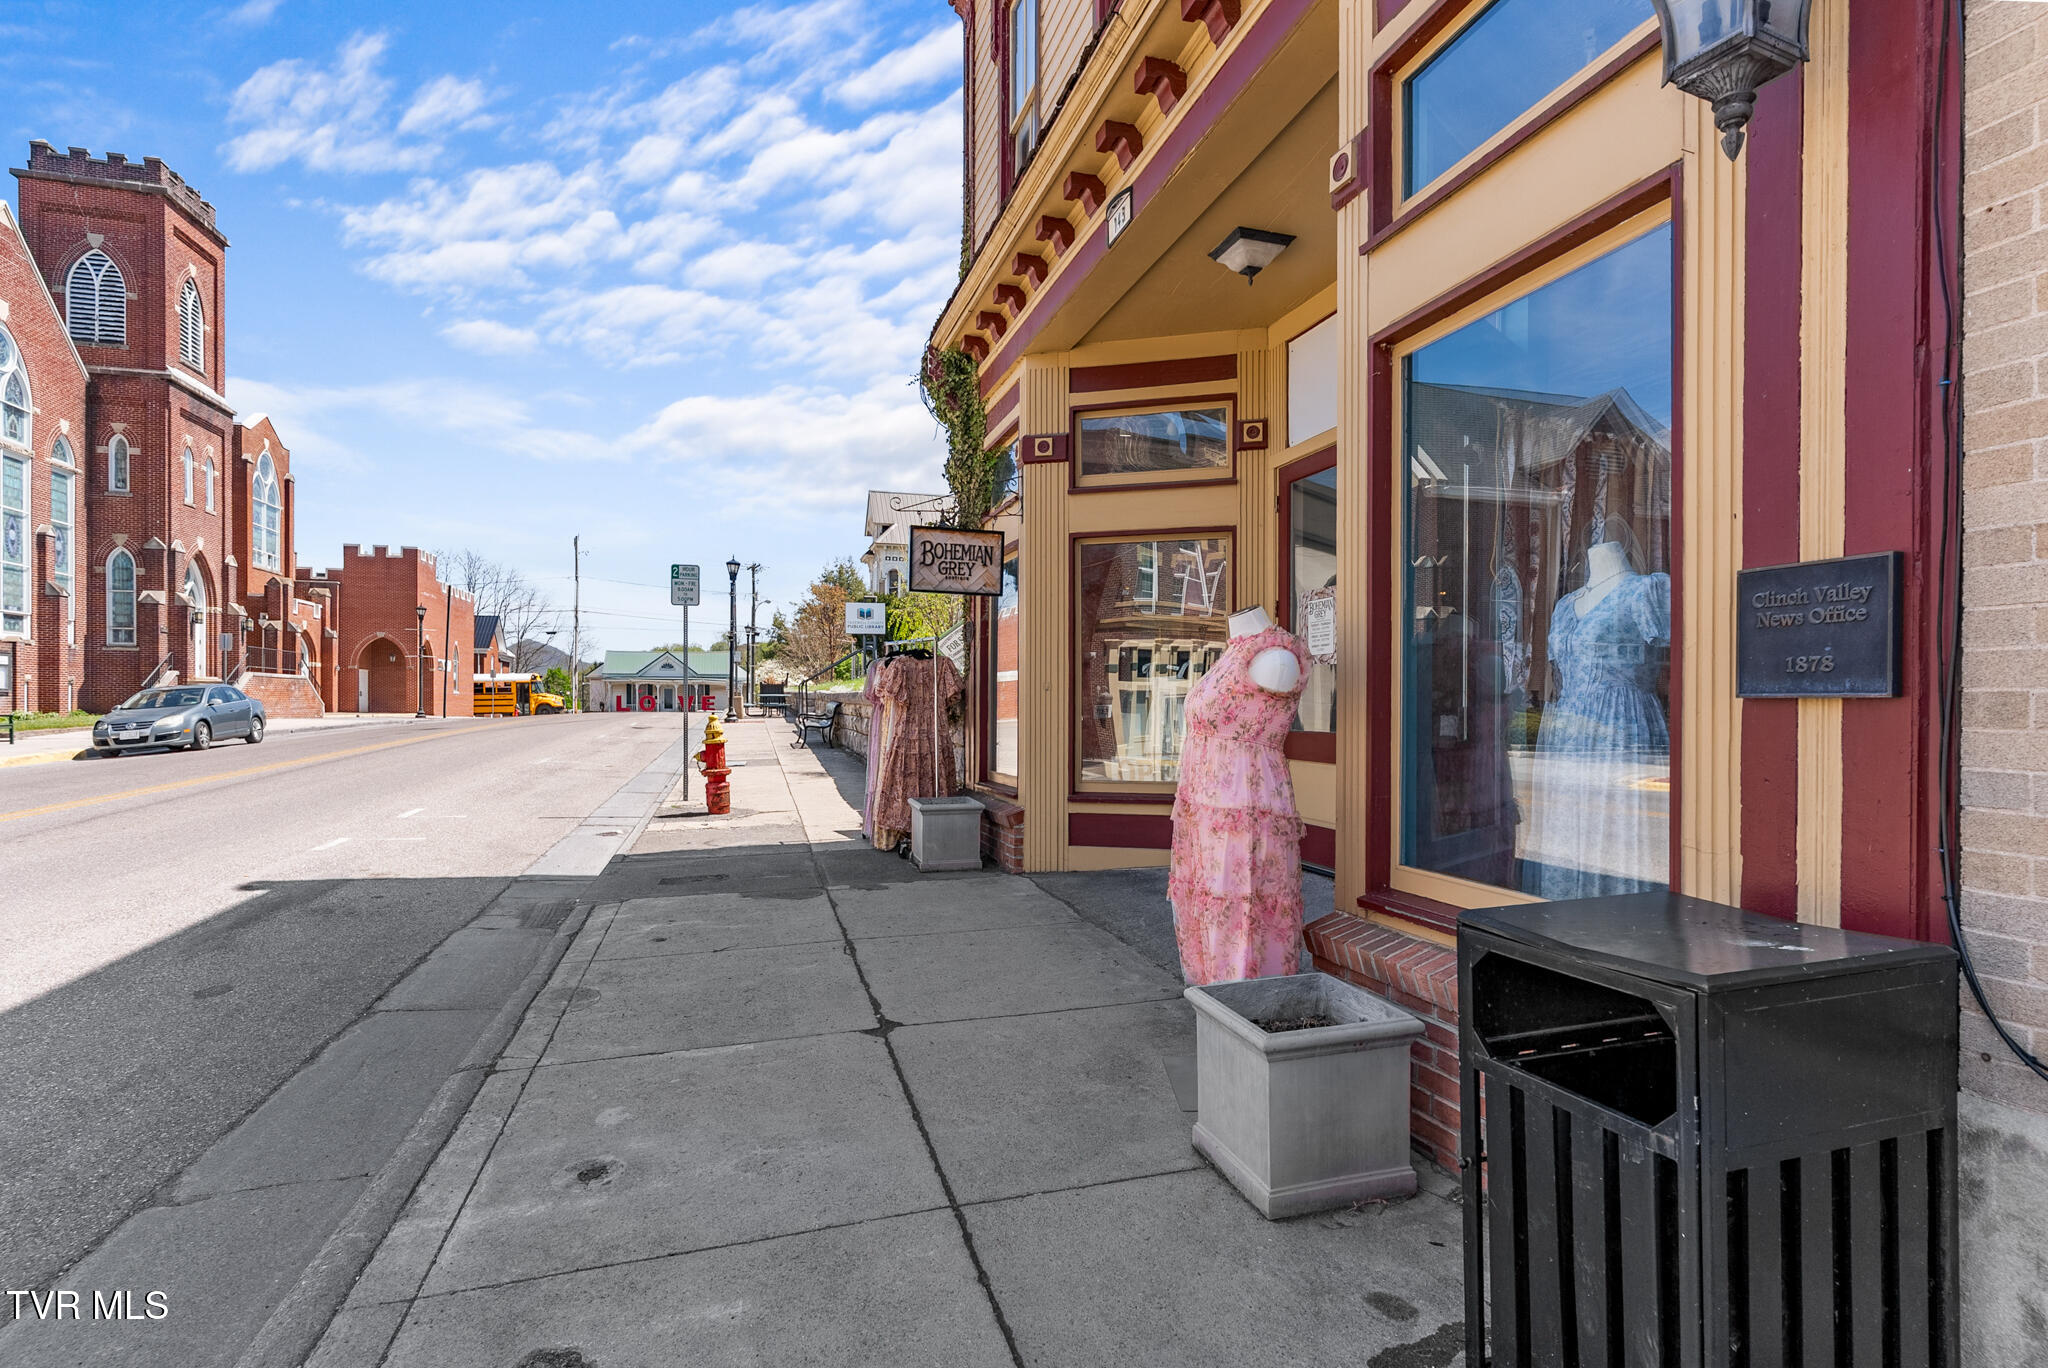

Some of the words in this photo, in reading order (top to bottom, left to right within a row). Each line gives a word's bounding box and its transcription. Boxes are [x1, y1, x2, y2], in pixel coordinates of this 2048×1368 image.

[920, 540, 994, 568] BOHEMIAN
[672, 566, 679, 577] 2
[938, 560, 976, 577] GREY
[1752, 588, 1809, 609] Clinch
[1814, 583, 1872, 604] Valley
[1757, 612, 1804, 629] News
[1809, 605, 1867, 625] Office
[946, 639, 960, 653] FOR
[1785, 655, 1834, 673] 1878
[616, 695, 715, 712] LOVE
